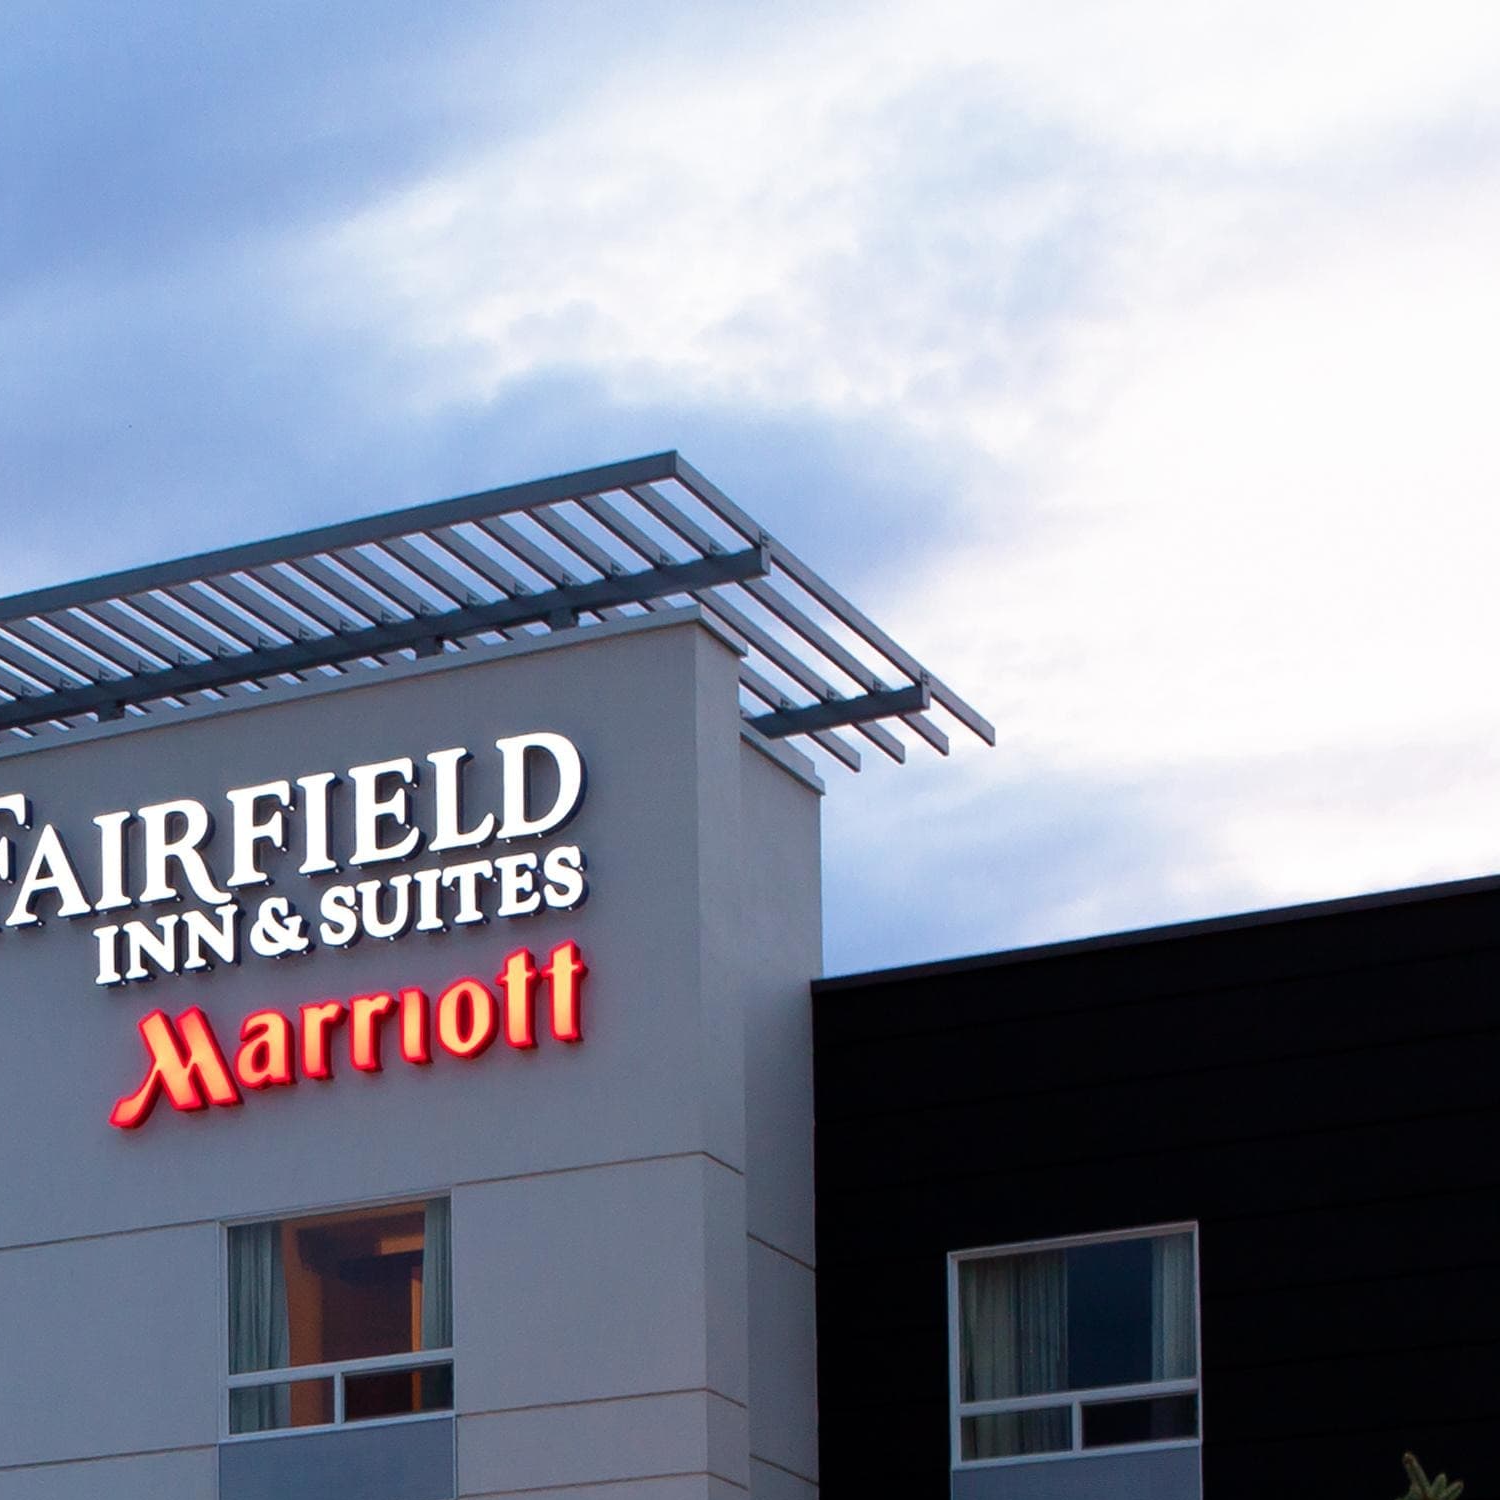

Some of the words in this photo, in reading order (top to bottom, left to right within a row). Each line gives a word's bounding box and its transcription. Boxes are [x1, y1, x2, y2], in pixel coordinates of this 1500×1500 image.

[95, 904, 238, 985] INN
[250, 897, 310, 958] &
[320, 845, 583, 946] SUITES
[108, 939, 588, 1128] Marriott
